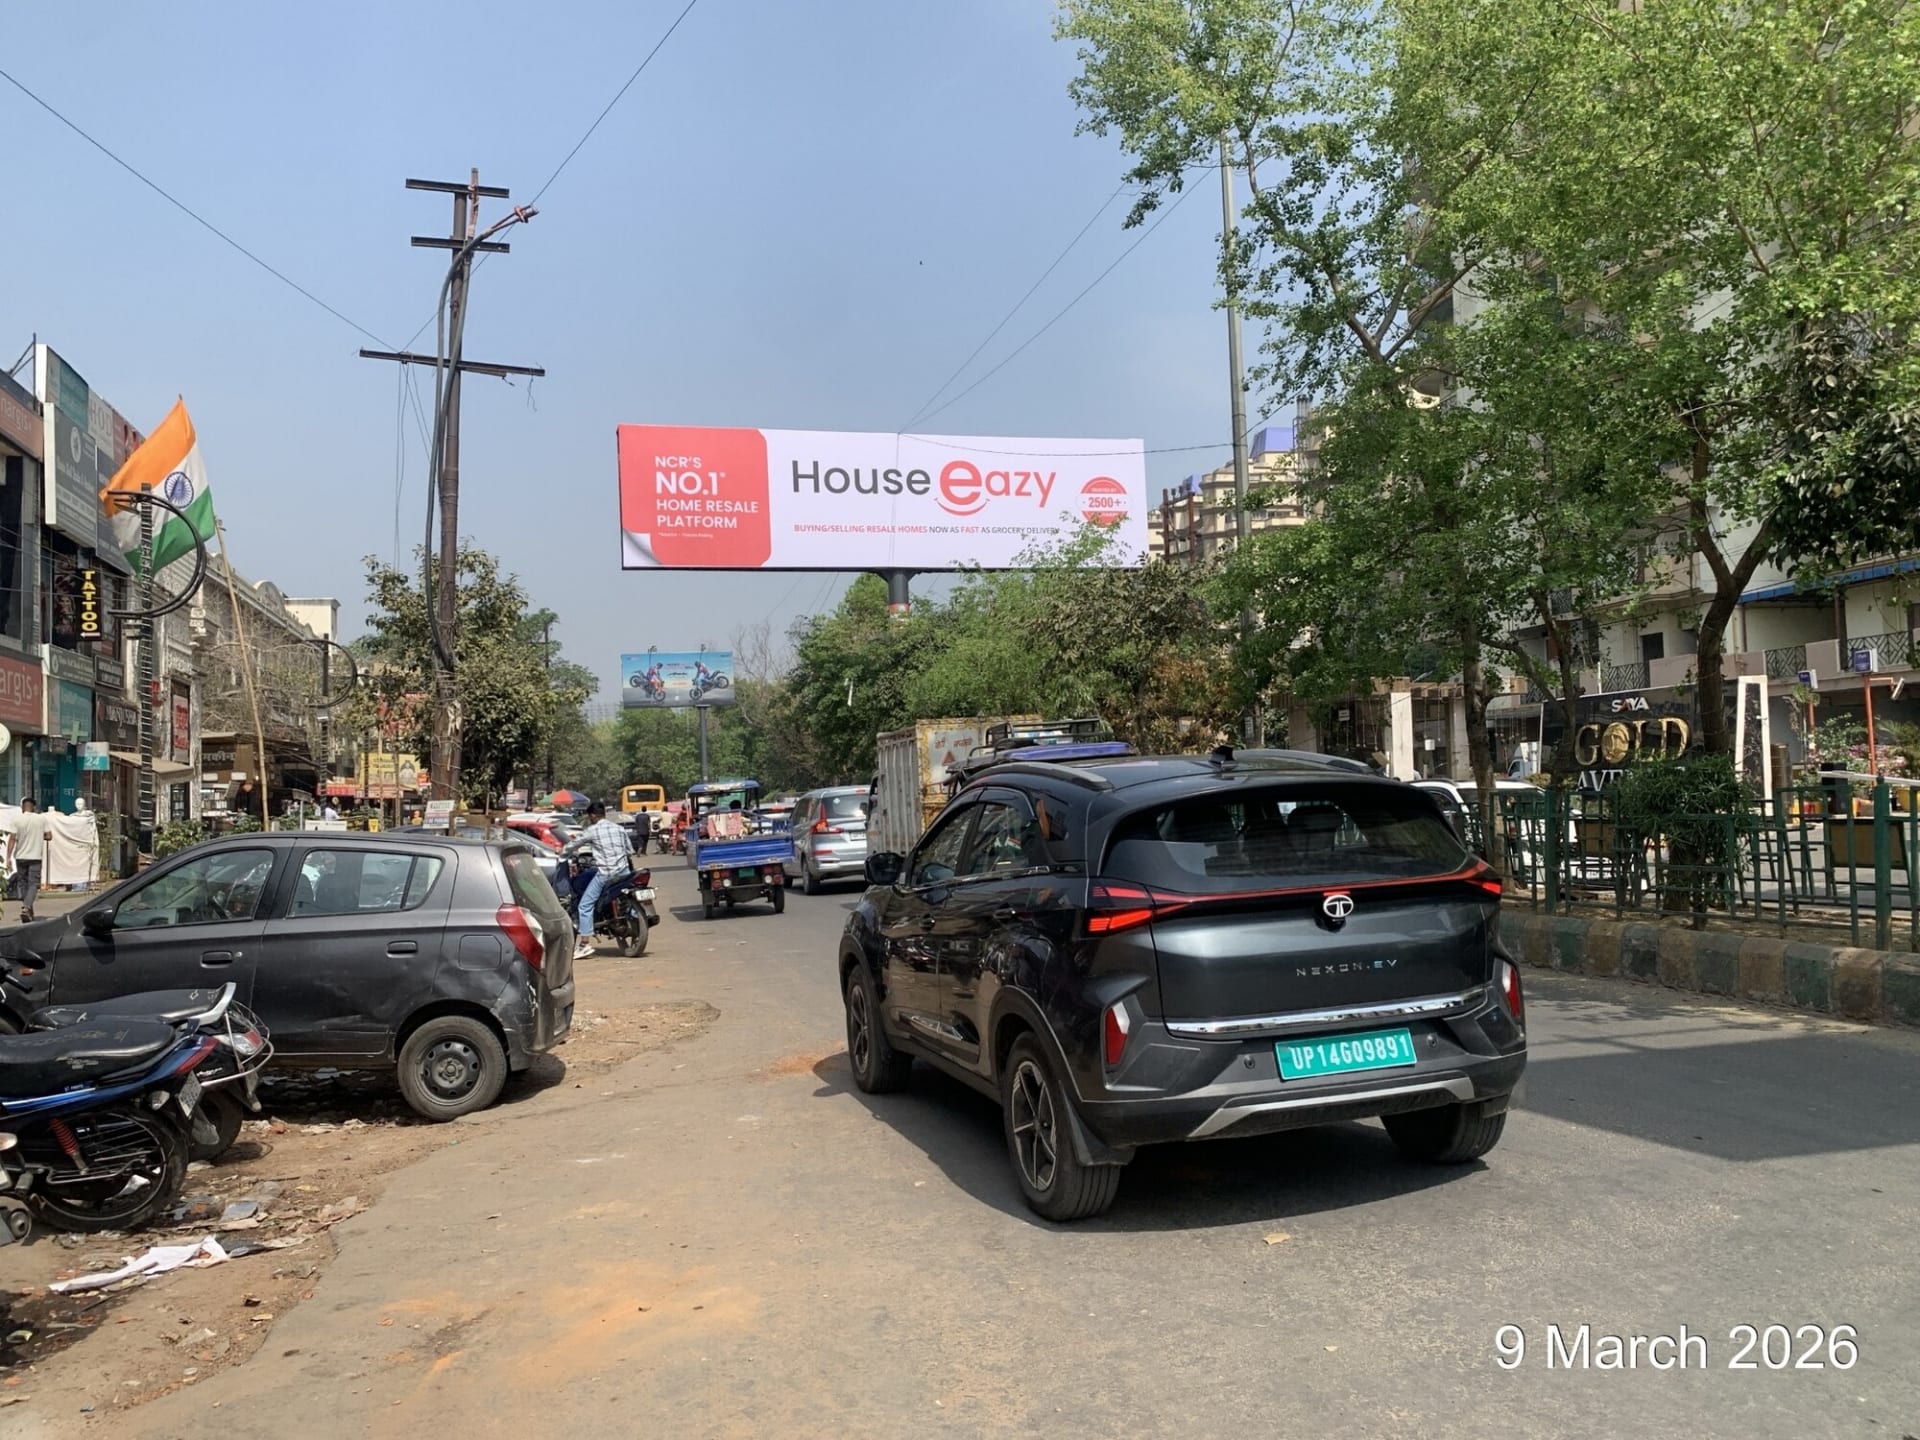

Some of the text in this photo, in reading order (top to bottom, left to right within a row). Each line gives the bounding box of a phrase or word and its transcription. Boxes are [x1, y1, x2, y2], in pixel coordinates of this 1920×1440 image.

[655, 455, 702, 469] NCR'S
[656, 499, 759, 513] HOME RESALE
[1088, 496, 1122, 508] 2500+
[657, 515, 738, 529] PLATFORM
[794, 524, 865, 533] BUYING/SELLING
[867, 525, 896, 533] RESALE
[898, 525, 928, 534] HOMES
[929, 526, 949, 534] NOW
[950, 526, 960, 534] AS
[961, 526, 979, 534] FAST
[981, 526, 991, 534] AS
[992, 526, 1025, 535] GROCERY
[81, 570, 98, 632] TATTOO
[1611, 696, 1650, 713] SAYA
[1575, 717, 1690, 766] GOLD
